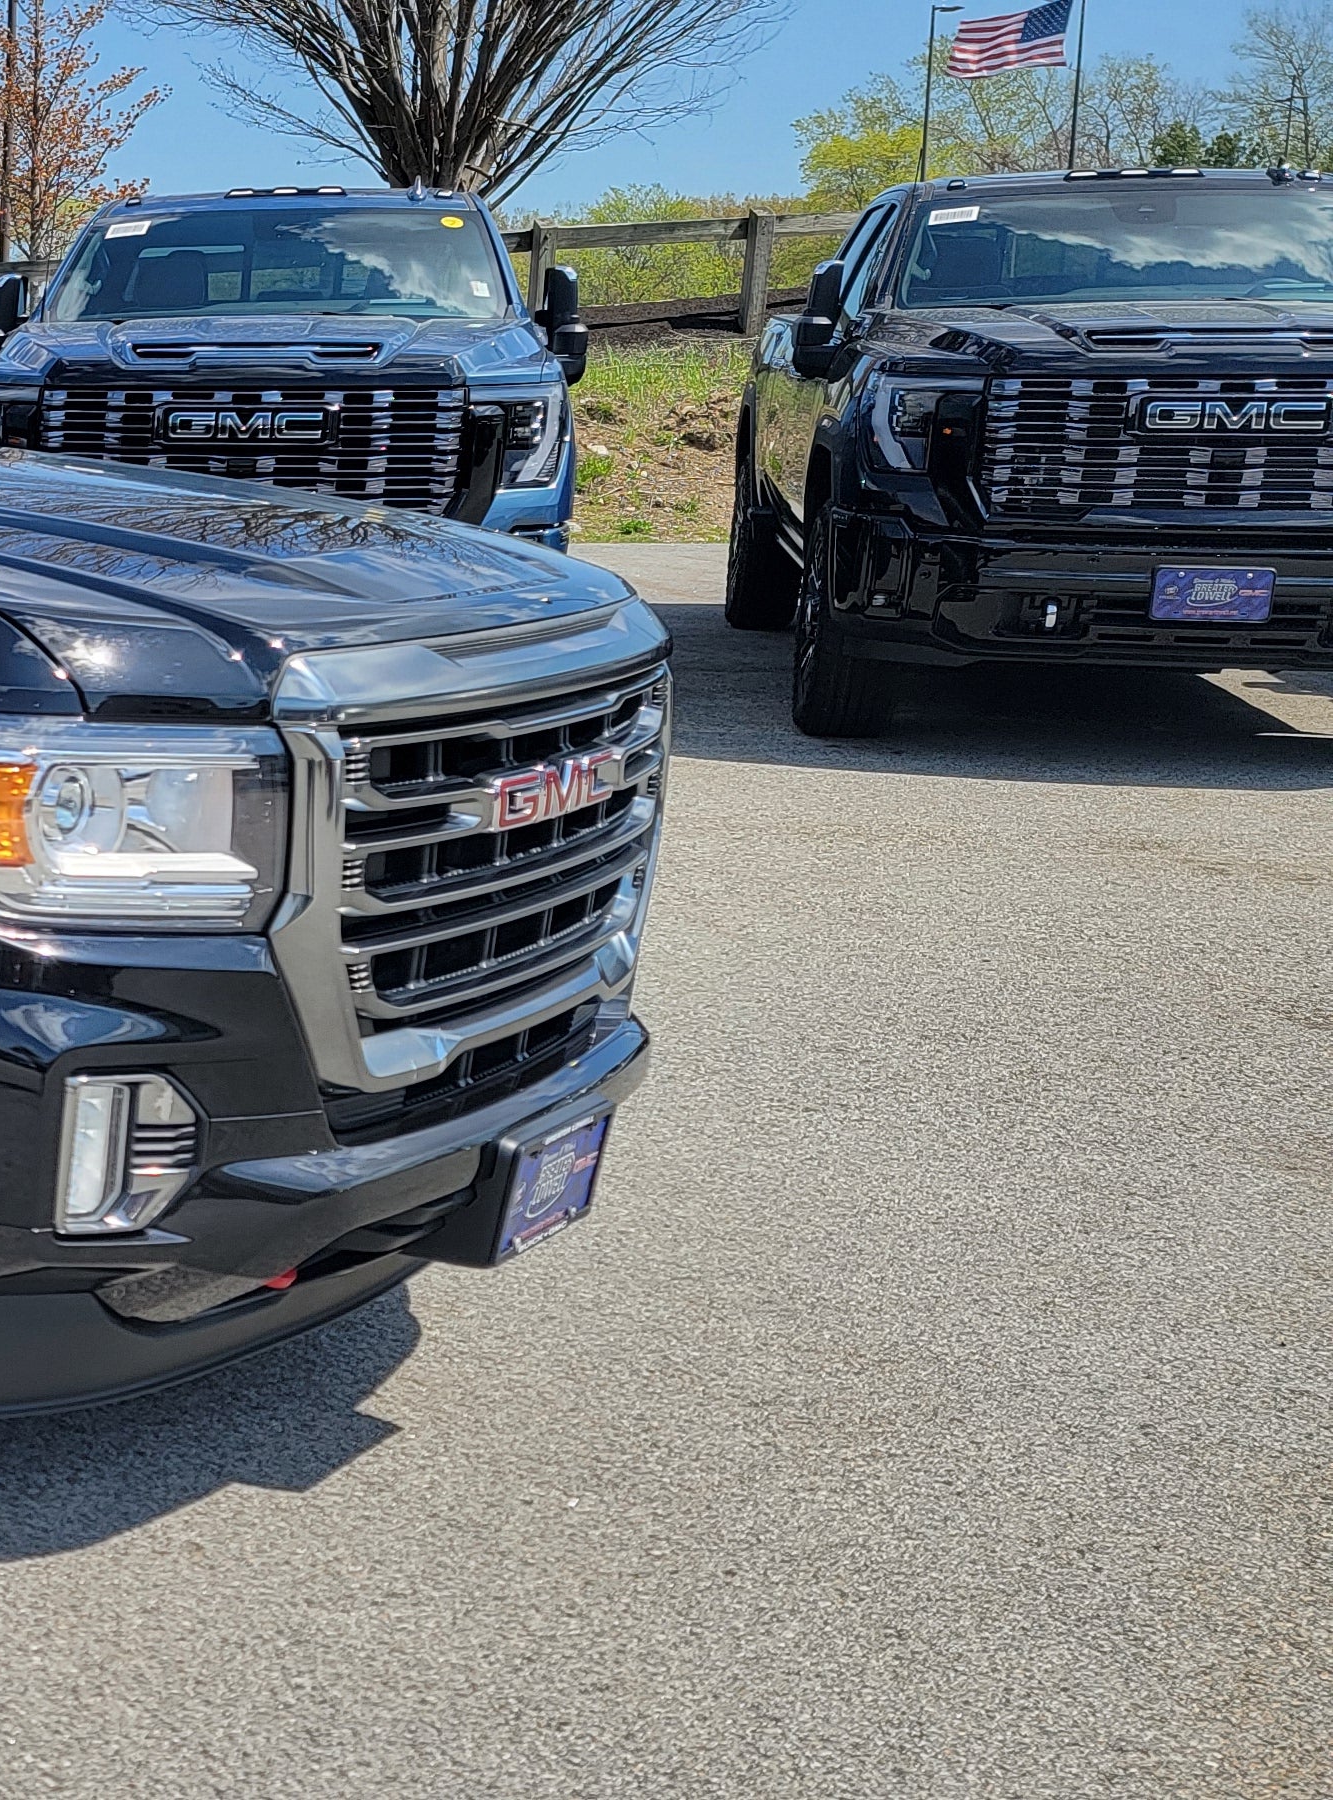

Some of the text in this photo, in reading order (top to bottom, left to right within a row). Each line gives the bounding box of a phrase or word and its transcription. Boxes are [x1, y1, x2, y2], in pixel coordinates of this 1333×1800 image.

[168, 411, 323, 438] GMC
[1145, 401, 1327, 430] GMC
[1190, 591, 1232, 601] LOWELL
[1194, 583, 1235, 592] GREATER
[497, 751, 615, 831] GMC
